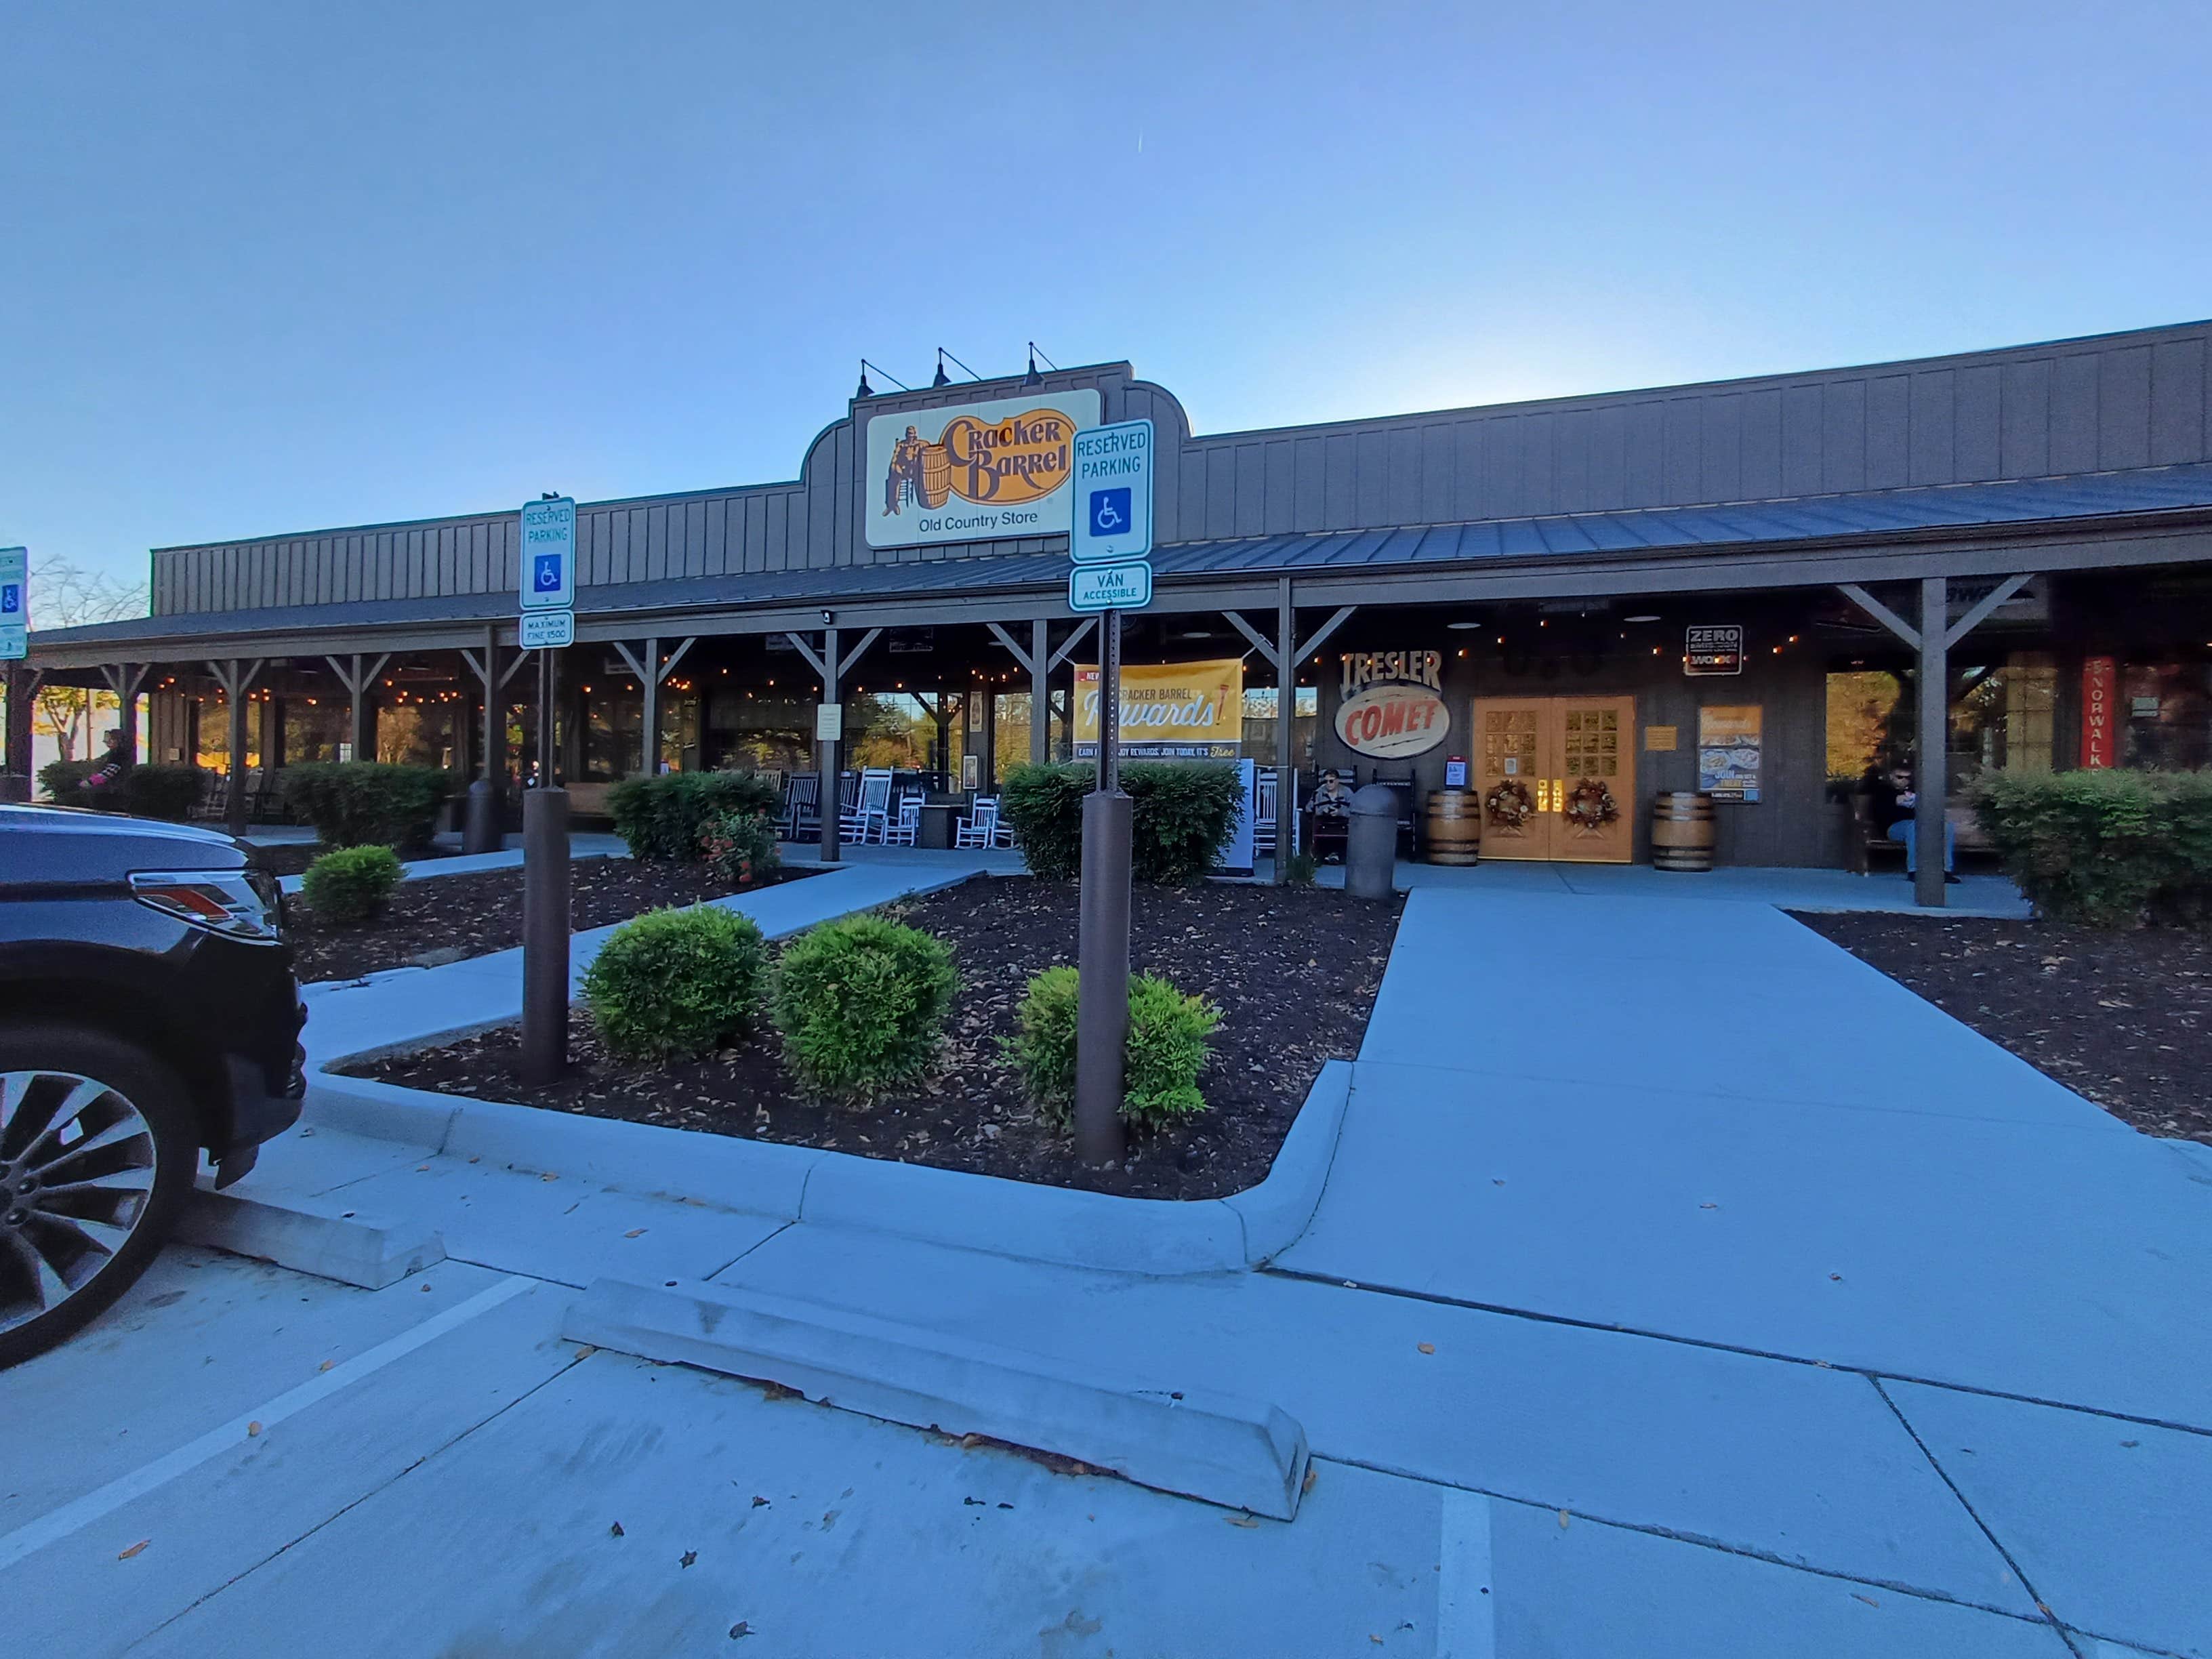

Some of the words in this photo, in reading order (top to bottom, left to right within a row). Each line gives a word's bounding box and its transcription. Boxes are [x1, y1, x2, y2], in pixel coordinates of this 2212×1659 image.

[944, 419, 1062, 467] Cracker
[1077, 432, 1146, 457] RESERVED
[968, 444, 1066, 500] Barrel
[1082, 456, 1141, 479] PARKING
[526, 508, 571, 526] RESERVED
[919, 518, 941, 532] Old
[945, 515, 998, 530] Country
[1002, 512, 1038, 525] Store
[528, 527, 568, 543] PARKING
[1097, 574, 1124, 588] VAN
[1083, 588, 1137, 600] ACCESSIBLE
[528, 619, 566, 630] MAXIMUM
[527, 631, 545, 640] FINE
[547, 630, 566, 639] $500
[1690, 629, 1739, 642] ZERO
[1339, 650, 1442, 693] TRESLER
[1159, 688, 1192, 700] BARREL
[1084, 684, 1229, 727] Rwards!
[1345, 700, 1439, 746] COMET
[2089, 678, 2104, 765] NORWALK
[1118, 747, 1129, 756] JOY
[1161, 747, 1174, 756] JOIN
[1210, 746, 1235, 758] Free
[1714, 770, 1735, 779] JOIN
